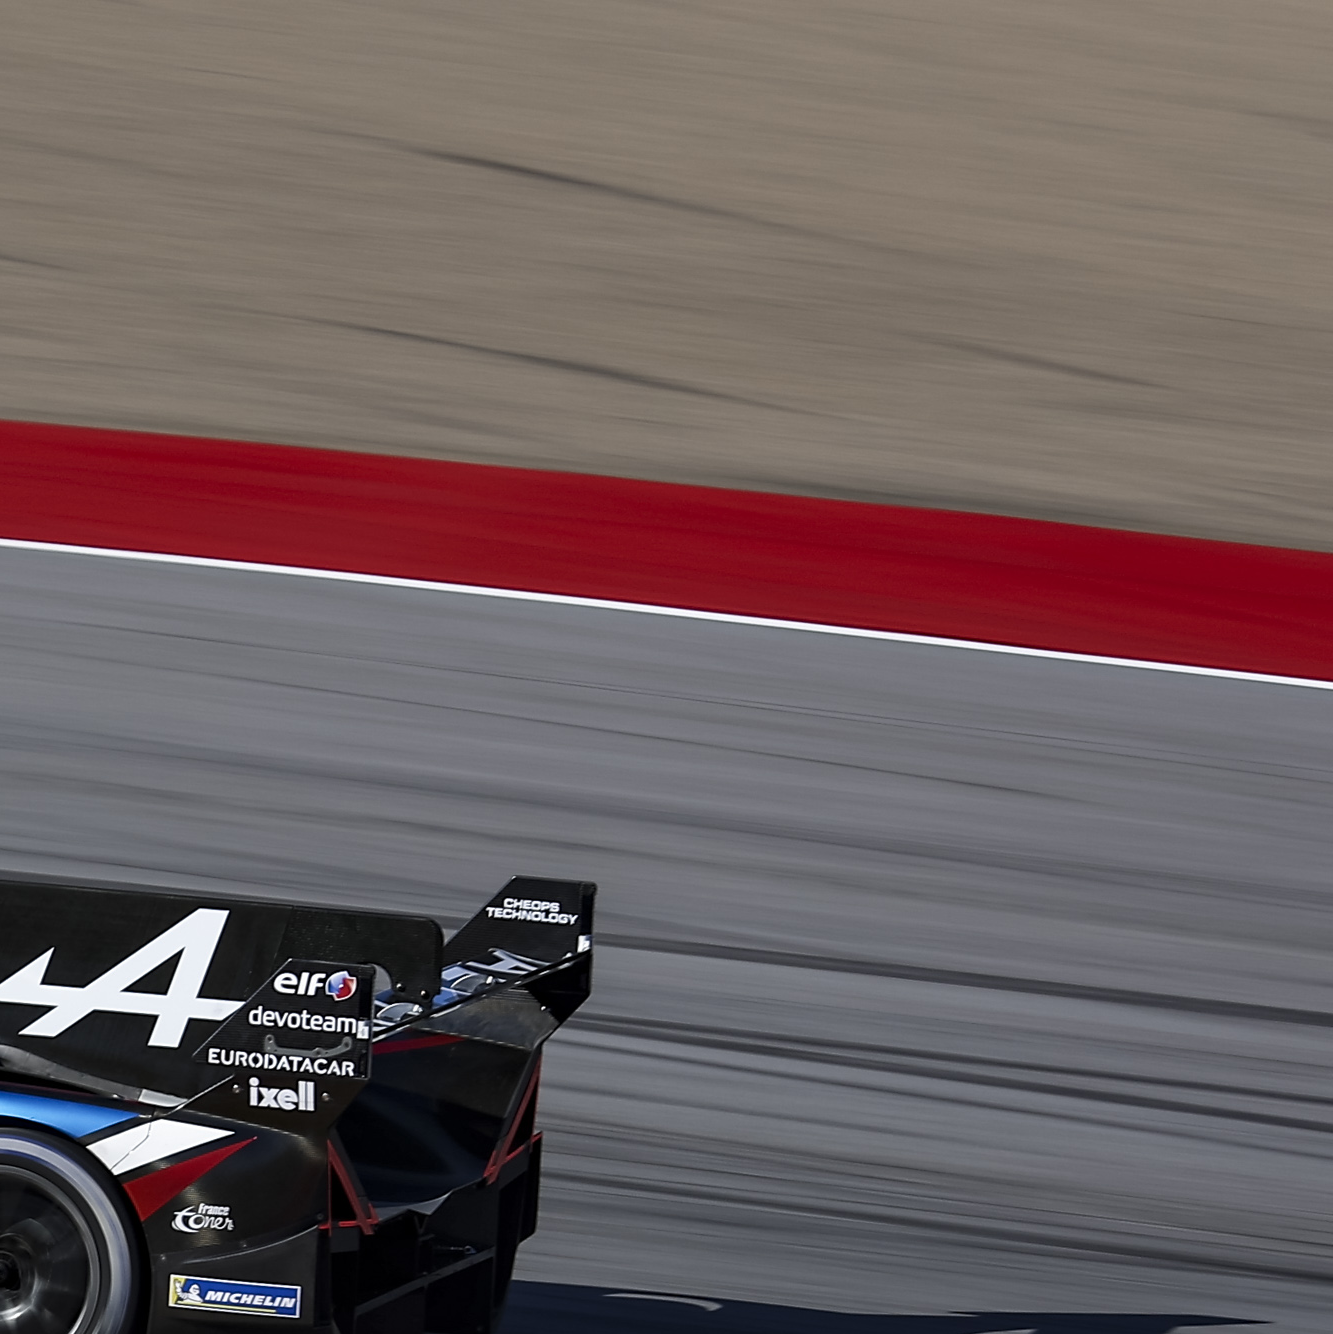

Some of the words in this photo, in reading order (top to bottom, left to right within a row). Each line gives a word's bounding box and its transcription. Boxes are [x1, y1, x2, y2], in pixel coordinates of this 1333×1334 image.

[486, 907, 578, 925] TECHNOLOGY
[504, 898, 560, 912] CHEOPS
[273, 972, 326, 995] elf
[249, 1006, 356, 1034] devoteam
[208, 1048, 354, 1076] EURODATACAR
[249, 1077, 315, 1111] ixell
[205, 1291, 296, 1308] MICHELIN
